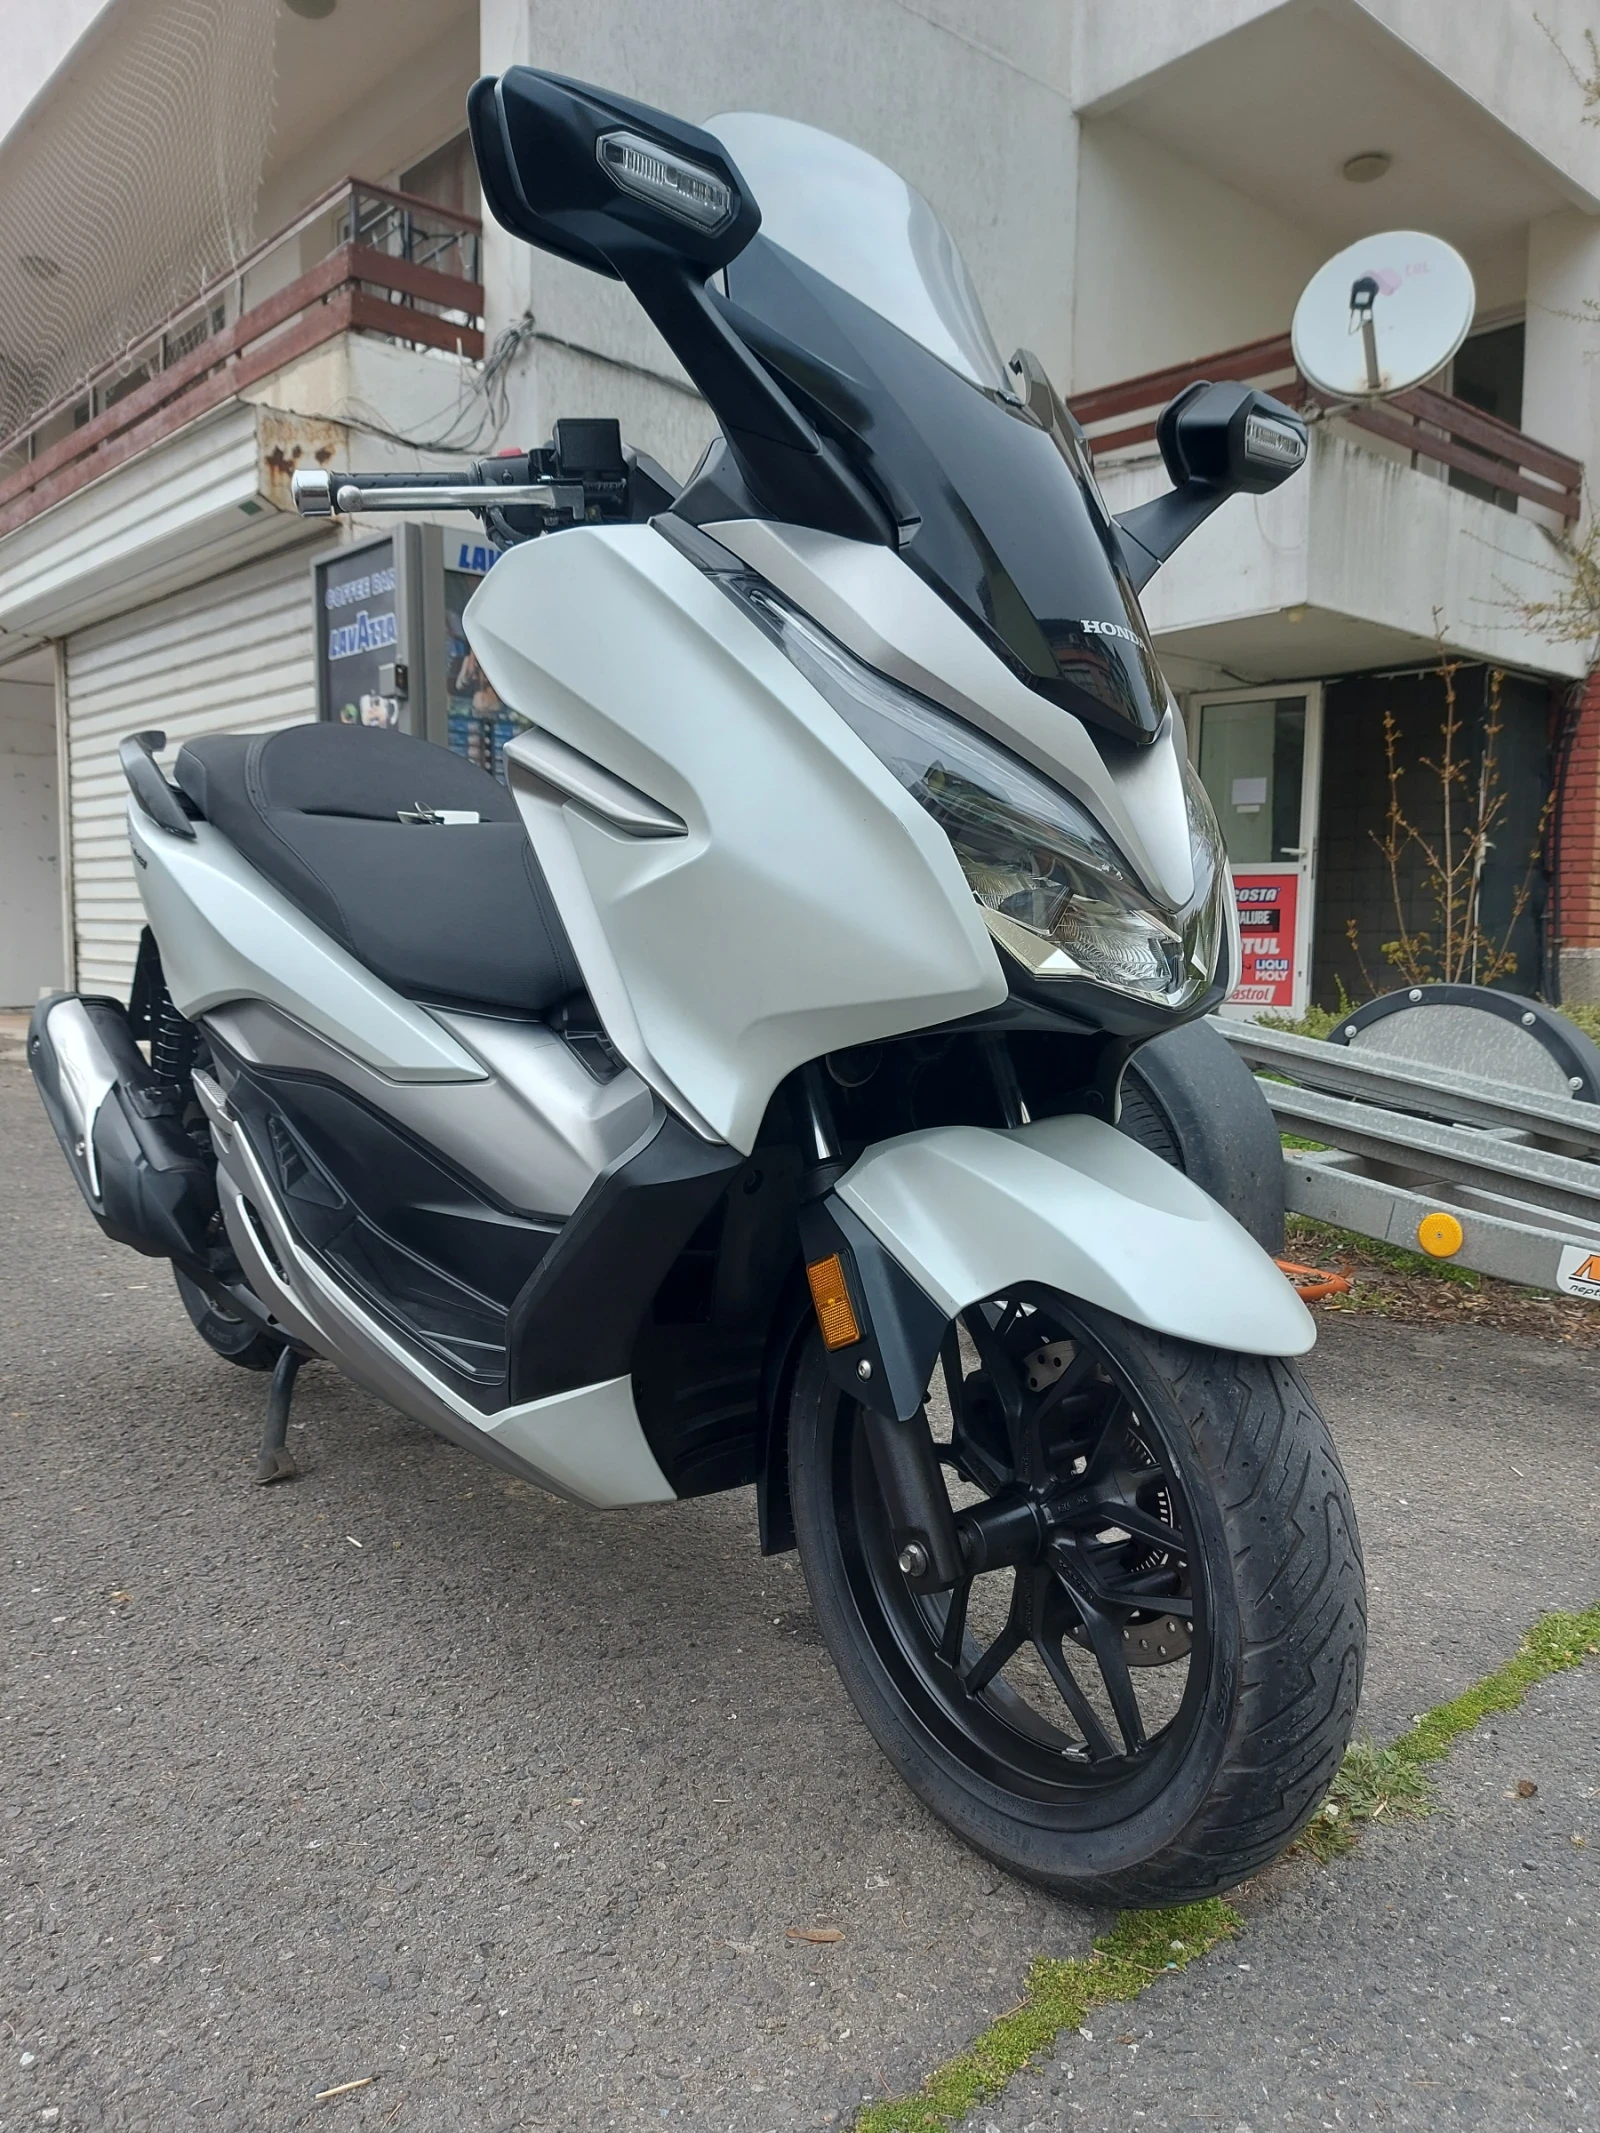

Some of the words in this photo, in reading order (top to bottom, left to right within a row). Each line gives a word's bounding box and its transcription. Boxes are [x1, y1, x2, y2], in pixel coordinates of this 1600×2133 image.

[459, 544, 502, 571] LAV
[325, 576, 371, 611] COFFEE
[328, 610, 398, 660] LAVAZZA
[1080, 619, 1149, 654] HONDA
[1238, 911, 1270, 925] ALUBE
[1241, 938, 1280, 954] TUL
[1255, 959, 1289, 970] LIQUI
[1255, 970, 1289, 982] MOLY
[1232, 988, 1269, 1001] astrol
[1570, 1285, 1600, 1296] nept
